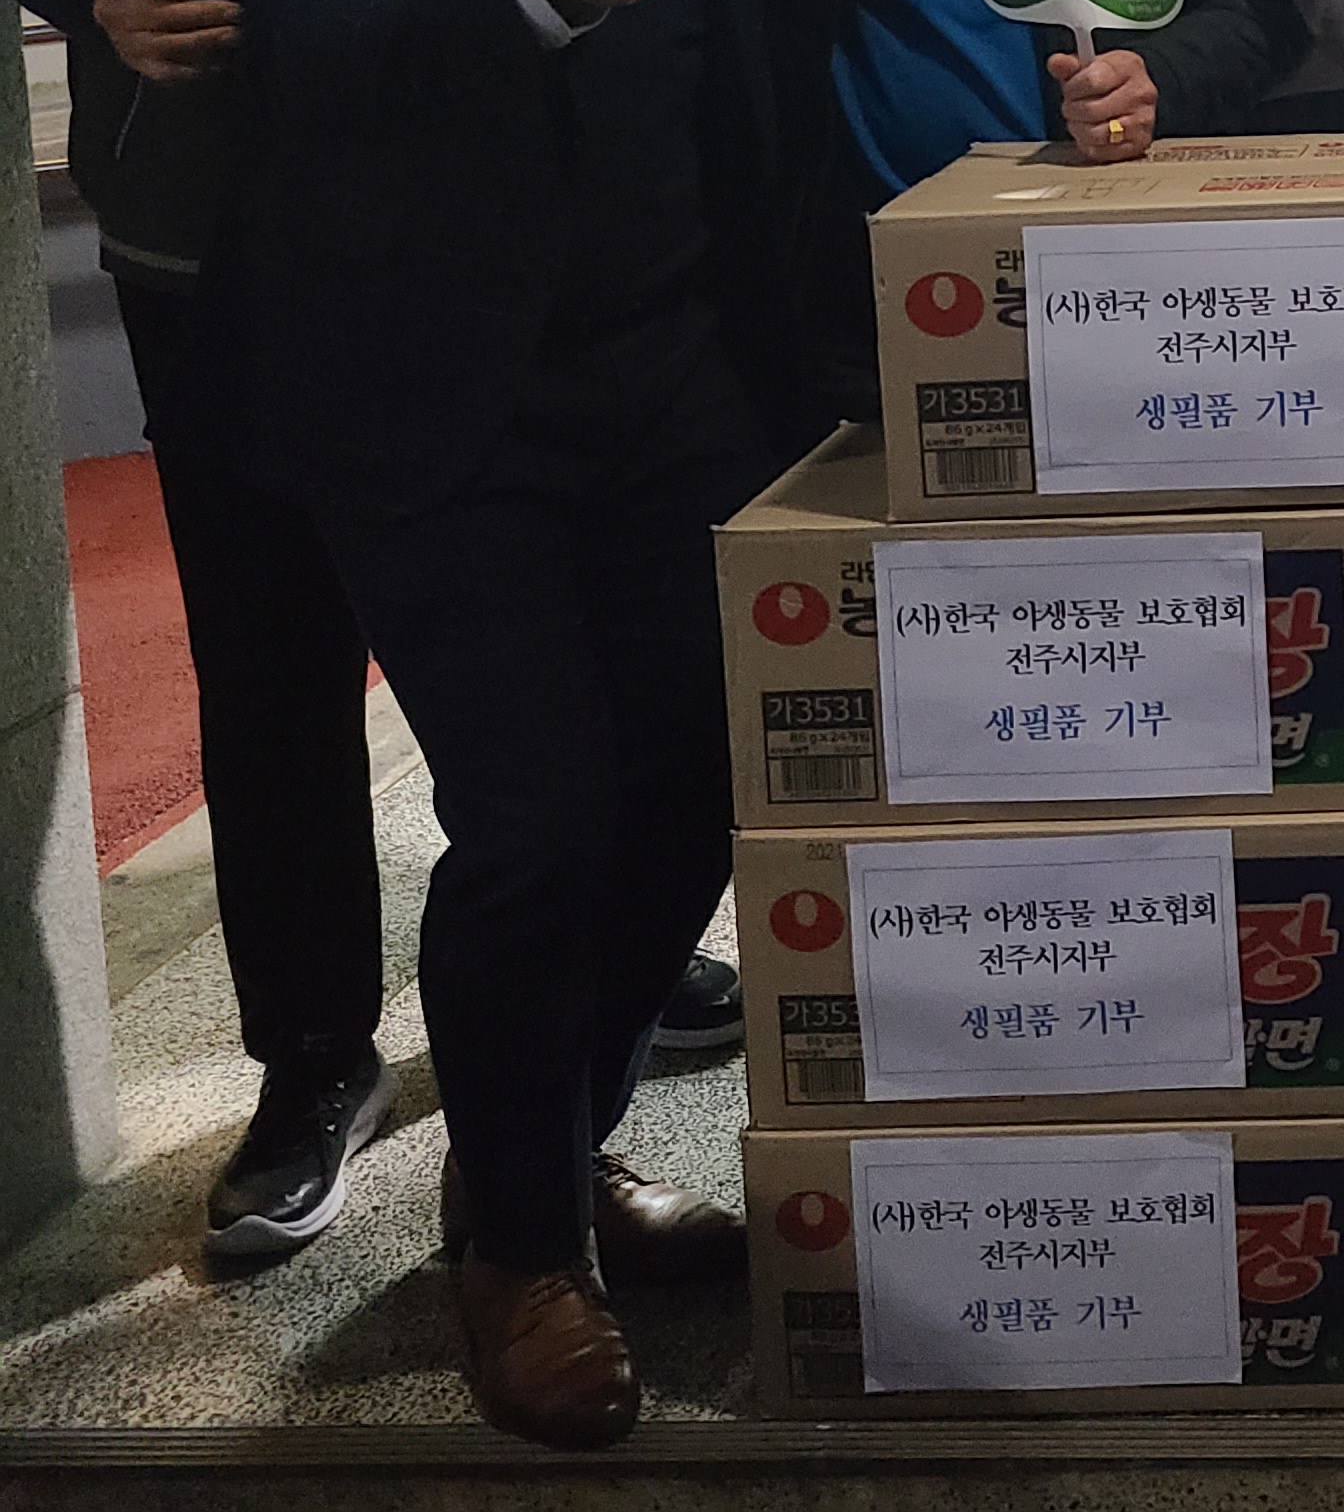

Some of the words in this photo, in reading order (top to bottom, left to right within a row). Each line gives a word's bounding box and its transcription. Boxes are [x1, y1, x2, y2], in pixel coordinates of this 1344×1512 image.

[1046, 290, 1150, 324] (사)한국
[1163, 287, 1275, 319] 야생동물
[1158, 330, 1296, 363] 전주시지부
[923, 388, 1024, 417] 가3531
[1136, 393, 1237, 430] 생필품
[1257, 390, 1323, 427] 기부
[897, 602, 1000, 637] (사)한국
[1012, 600, 1124, 631] 야생동물
[1137, 595, 1244, 627] 보호협회
[1007, 641, 1145, 674] 전주시지부
[768, 696, 868, 726] 가3531
[985, 704, 1086, 741] 생필품
[1106, 701, 1171, 737] 기부
[870, 904, 971, 939] (사)한국
[984, 900, 1095, 932] 야생동물
[1108, 893, 1215, 925] 보호협회
[980, 941, 1116, 975] 전주시지부
[961, 1004, 1059, 1039] 생필품
[1078, 1000, 1144, 1034] 기부
[873, 1200, 973, 1233] (사)한국
[986, 1198, 1094, 1229] 야생동물
[1107, 1193, 1214, 1224] 보호협회
[980, 1239, 1115, 1270] 전주시지부
[960, 1298, 1059, 1333] 생필품
[1078, 1296, 1141, 1330] 기부
